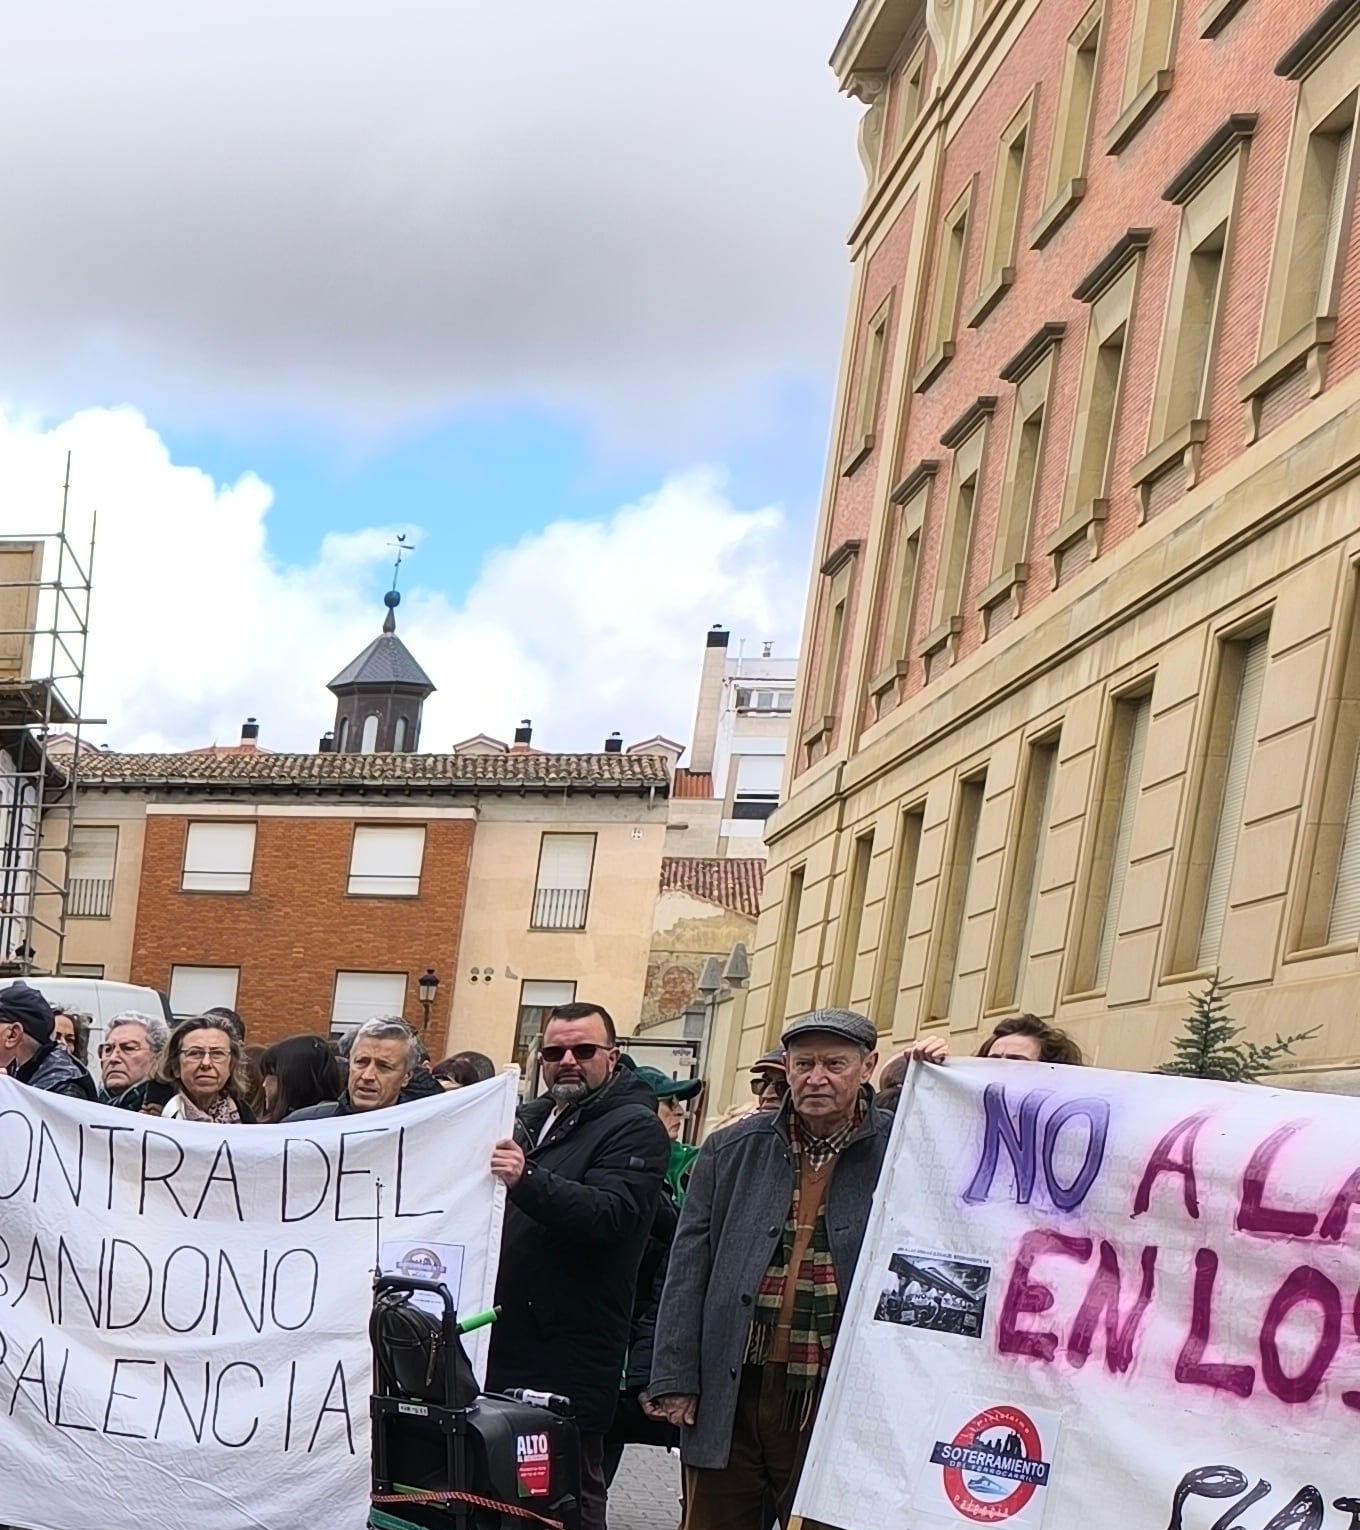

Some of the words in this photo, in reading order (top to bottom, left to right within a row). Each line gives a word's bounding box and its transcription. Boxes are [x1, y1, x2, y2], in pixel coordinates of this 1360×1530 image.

[281, 1126, 444, 1224] DEL
[962, 1083, 1110, 1213] NO
[1132, 1108, 1215, 1220] A
[998, 1229, 1158, 1375] EN
[517, 1434, 548, 1455] ALTO
[941, 1446, 1045, 1477] SOTERRAMIENTO
[950, 1460, 967, 1469] DEL
[971, 1463, 1033, 1482] FERROCARRIL
